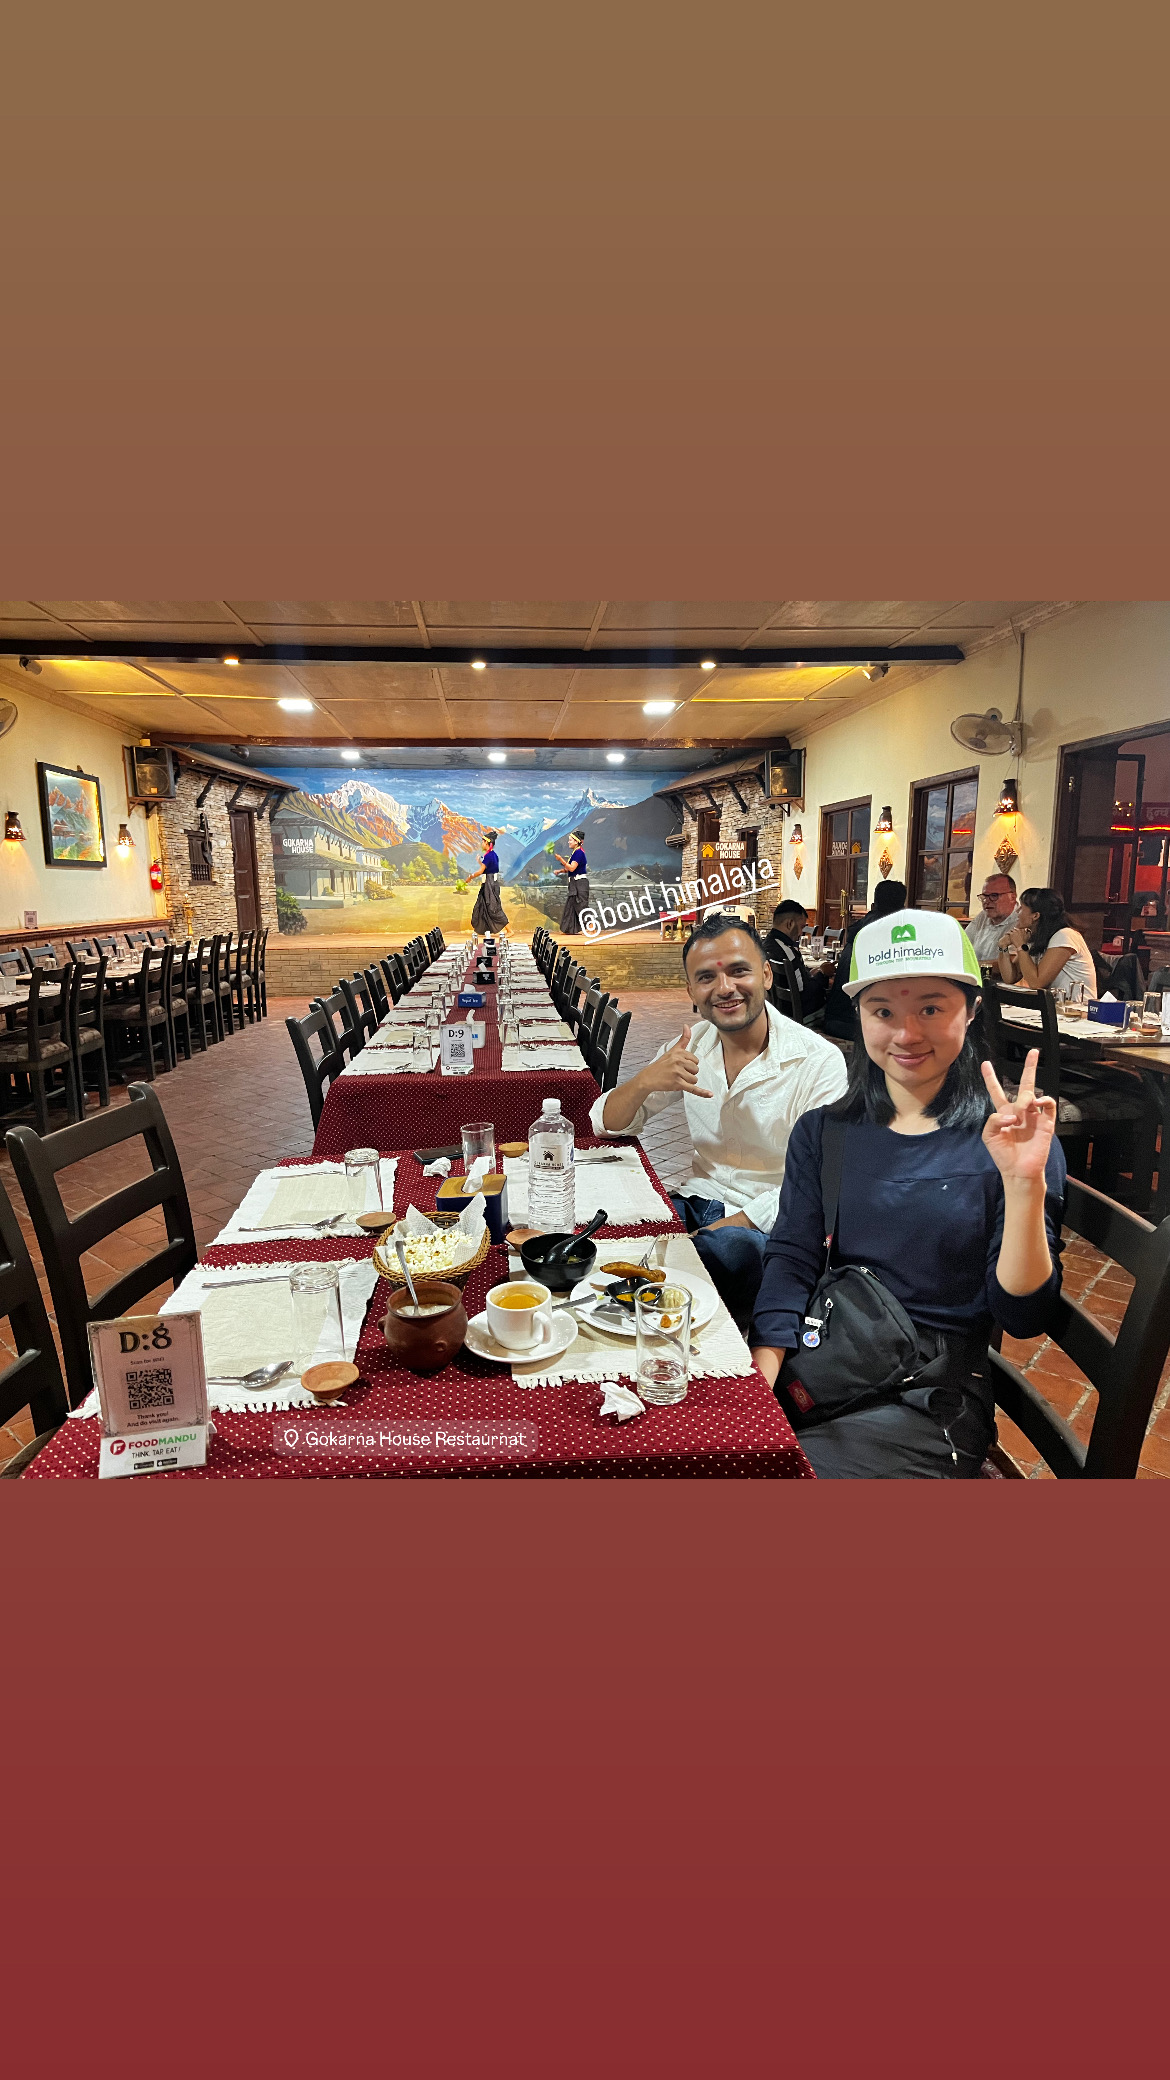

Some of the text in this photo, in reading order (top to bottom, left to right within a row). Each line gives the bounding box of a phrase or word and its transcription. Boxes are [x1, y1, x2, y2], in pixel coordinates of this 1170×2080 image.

[283, 839, 314, 847] GOKARNA
[715, 842, 745, 851] GOKARNA
[291, 846, 314, 854] HOUSE
[719, 851, 741, 859] HOUSE
[868, 945, 944, 965] bold himalaya
[448, 1029, 465, 1038] D:9
[128, 1433, 197, 1450] FOODMANDU
